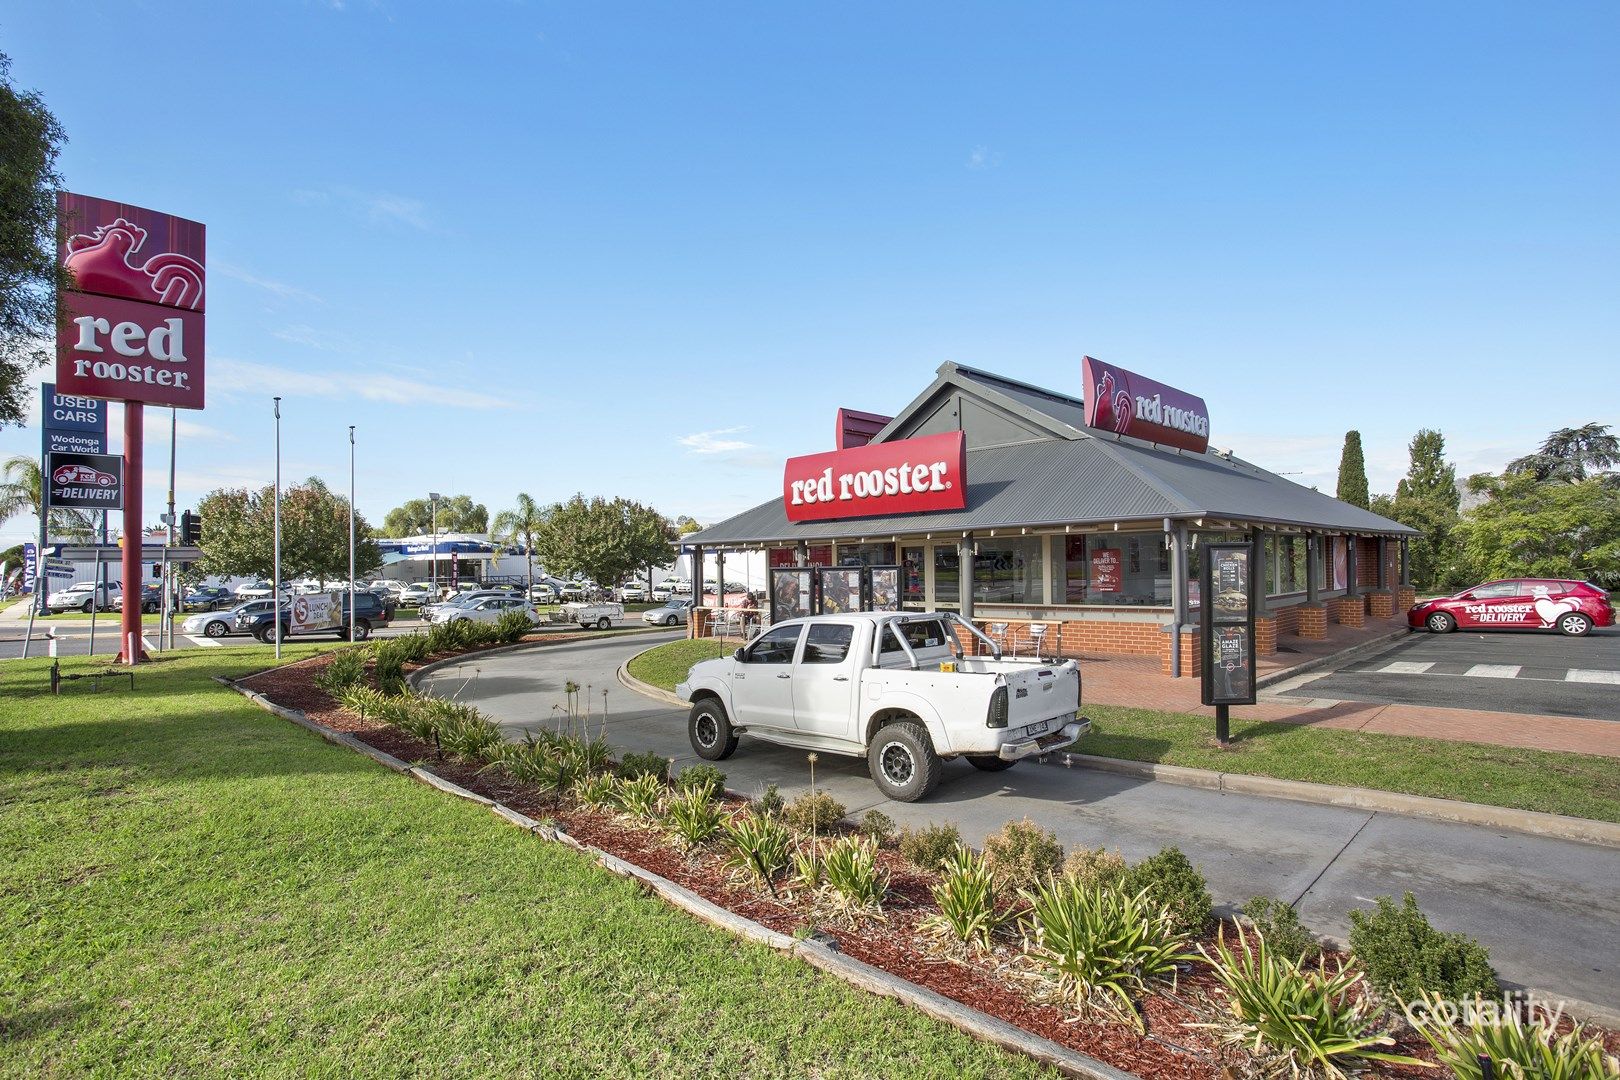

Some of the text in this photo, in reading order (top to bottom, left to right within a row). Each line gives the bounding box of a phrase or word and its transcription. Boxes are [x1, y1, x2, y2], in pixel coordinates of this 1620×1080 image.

[73, 315, 187, 362] red
[74, 359, 189, 388] rooster
[53, 395, 98, 410] USED
[53, 409, 98, 424] CARS
[1135, 394, 1207, 437] red rooster
[51, 434, 99, 446] Wodonga
[51, 443, 99, 454] Car World
[791, 461, 946, 506] red rooster
[62, 487, 119, 500] DELIVERY
[309, 602, 328, 612] LUNCH
[1465, 604, 1532, 613] red rooster
[1480, 613, 1526, 622] DELIVERY
